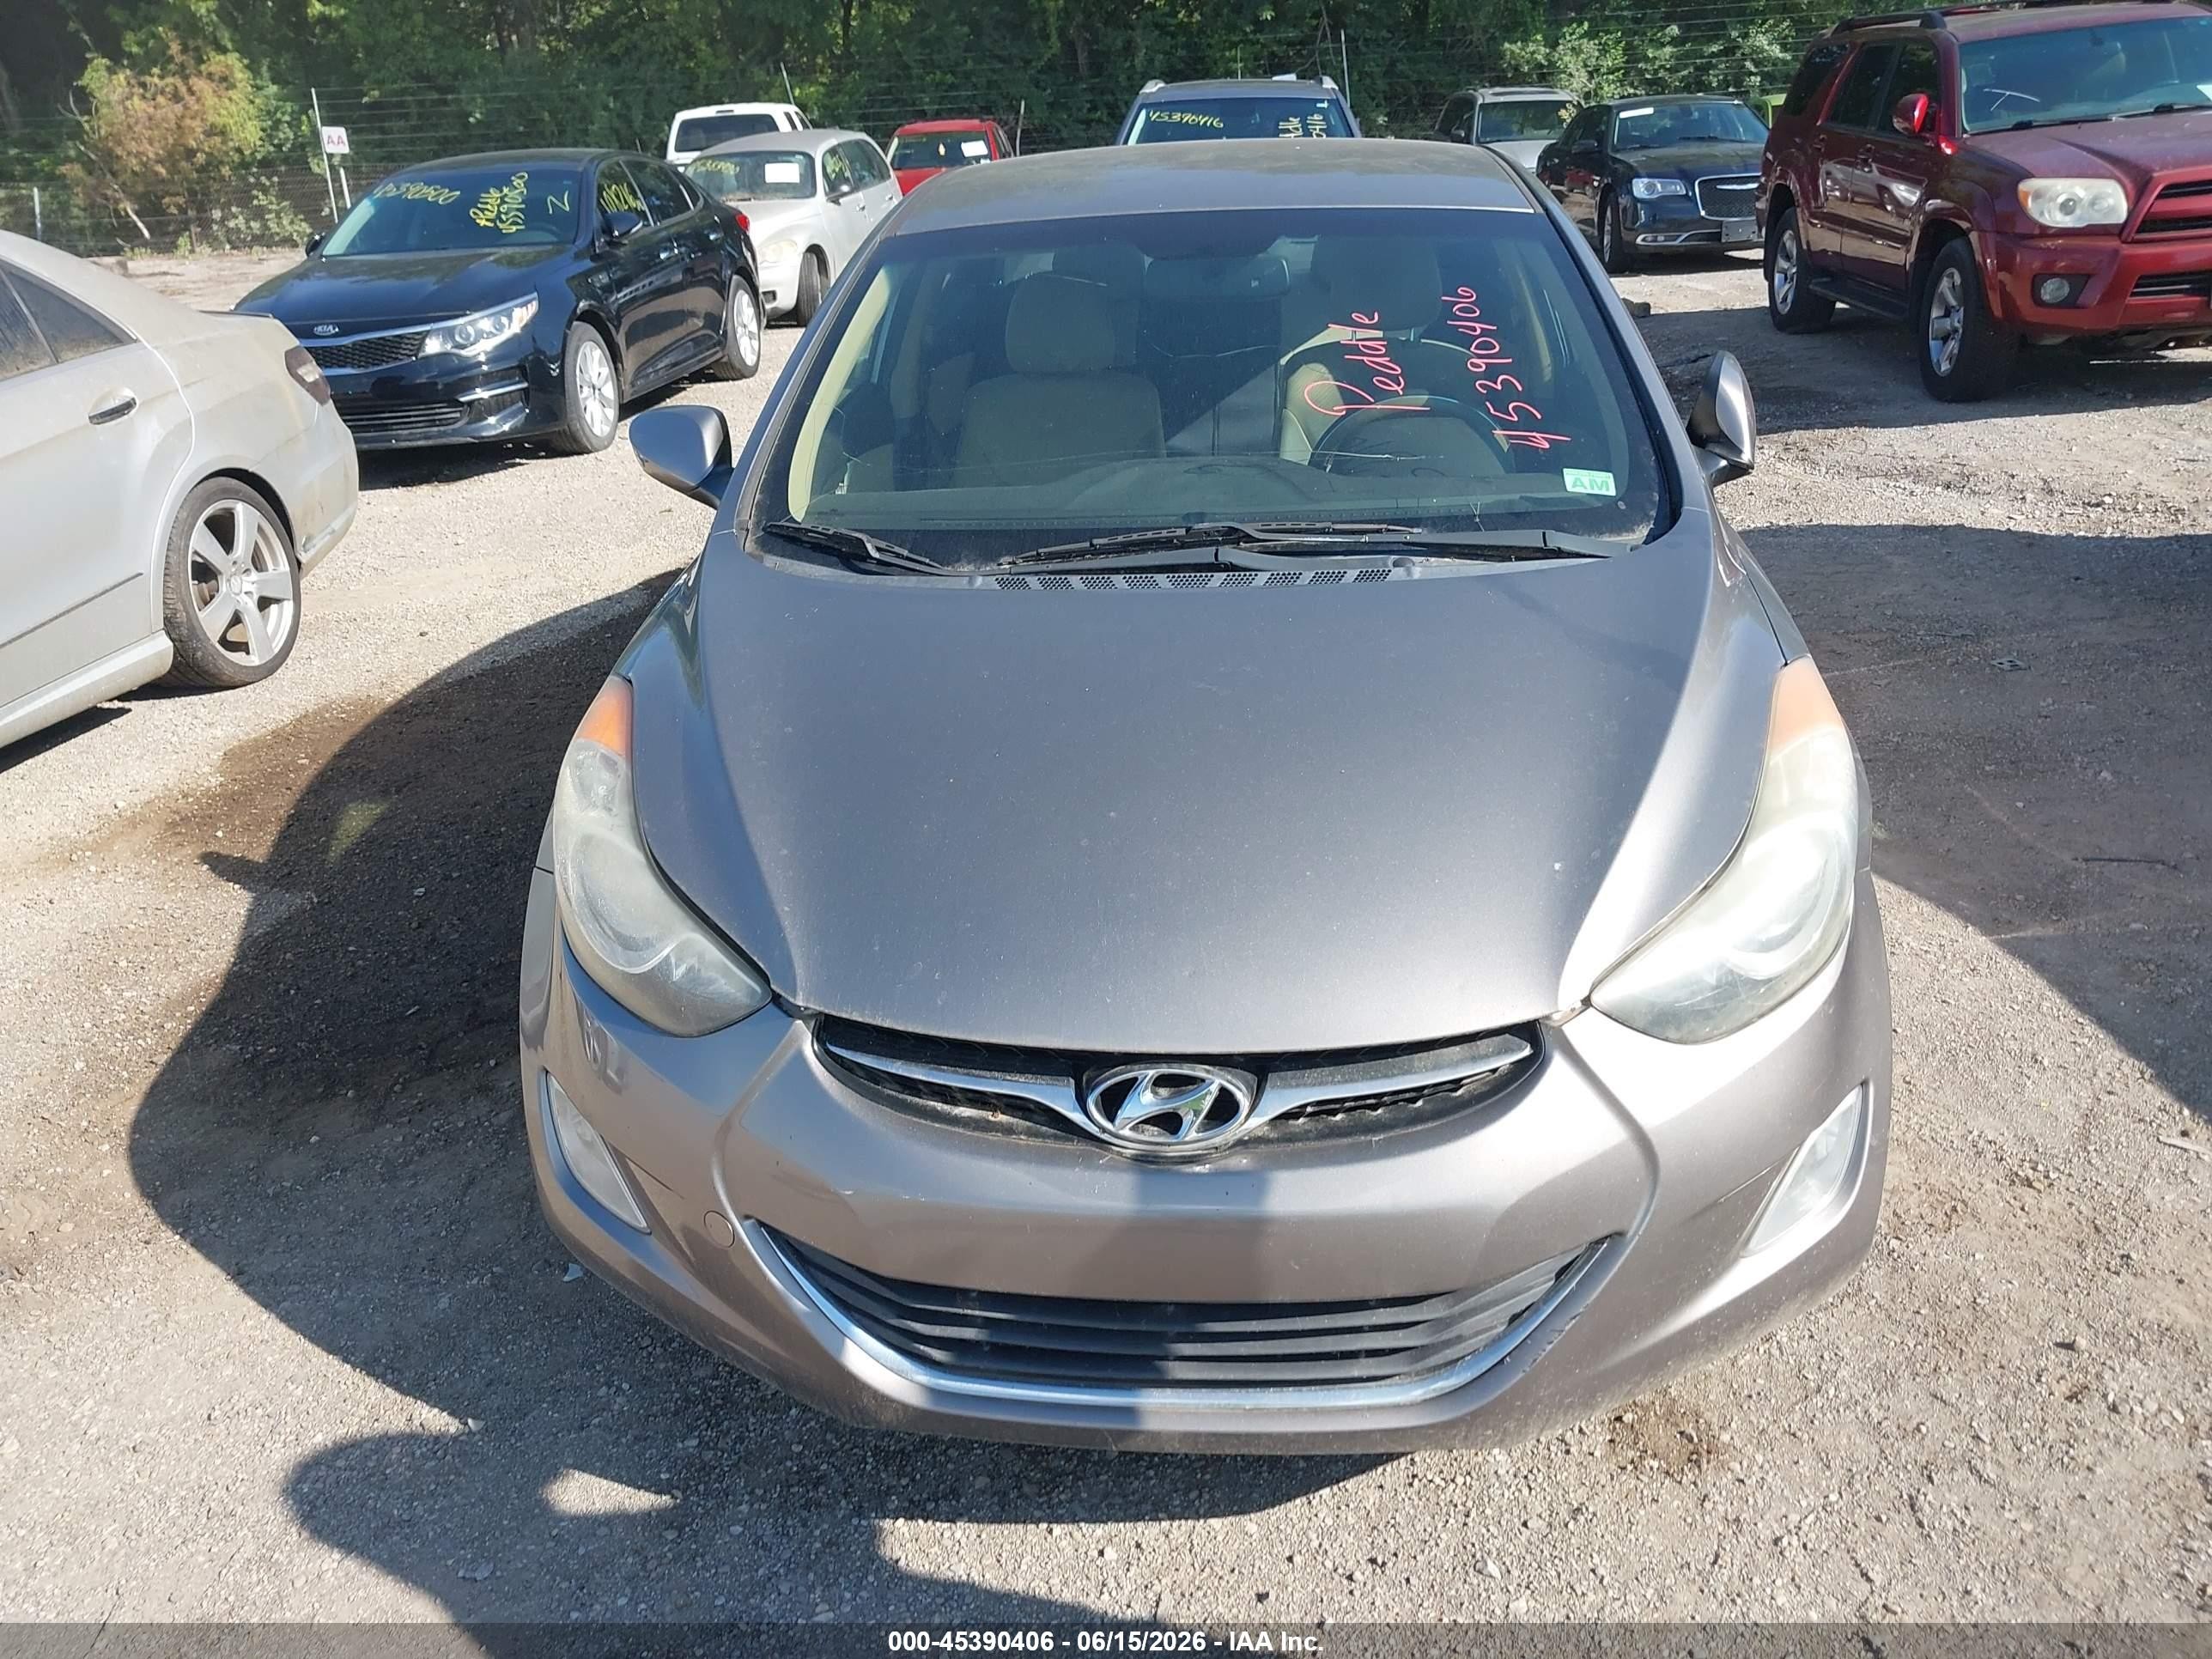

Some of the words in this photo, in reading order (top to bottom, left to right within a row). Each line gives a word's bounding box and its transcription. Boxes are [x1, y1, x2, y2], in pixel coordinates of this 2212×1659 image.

[1149, 109, 1224, 128] 45390416
[327, 135, 345, 146] AA
[1304, 310, 1431, 416] Peddle
[1441, 286, 1572, 449] 45390406
[1571, 477, 1610, 492] AM
